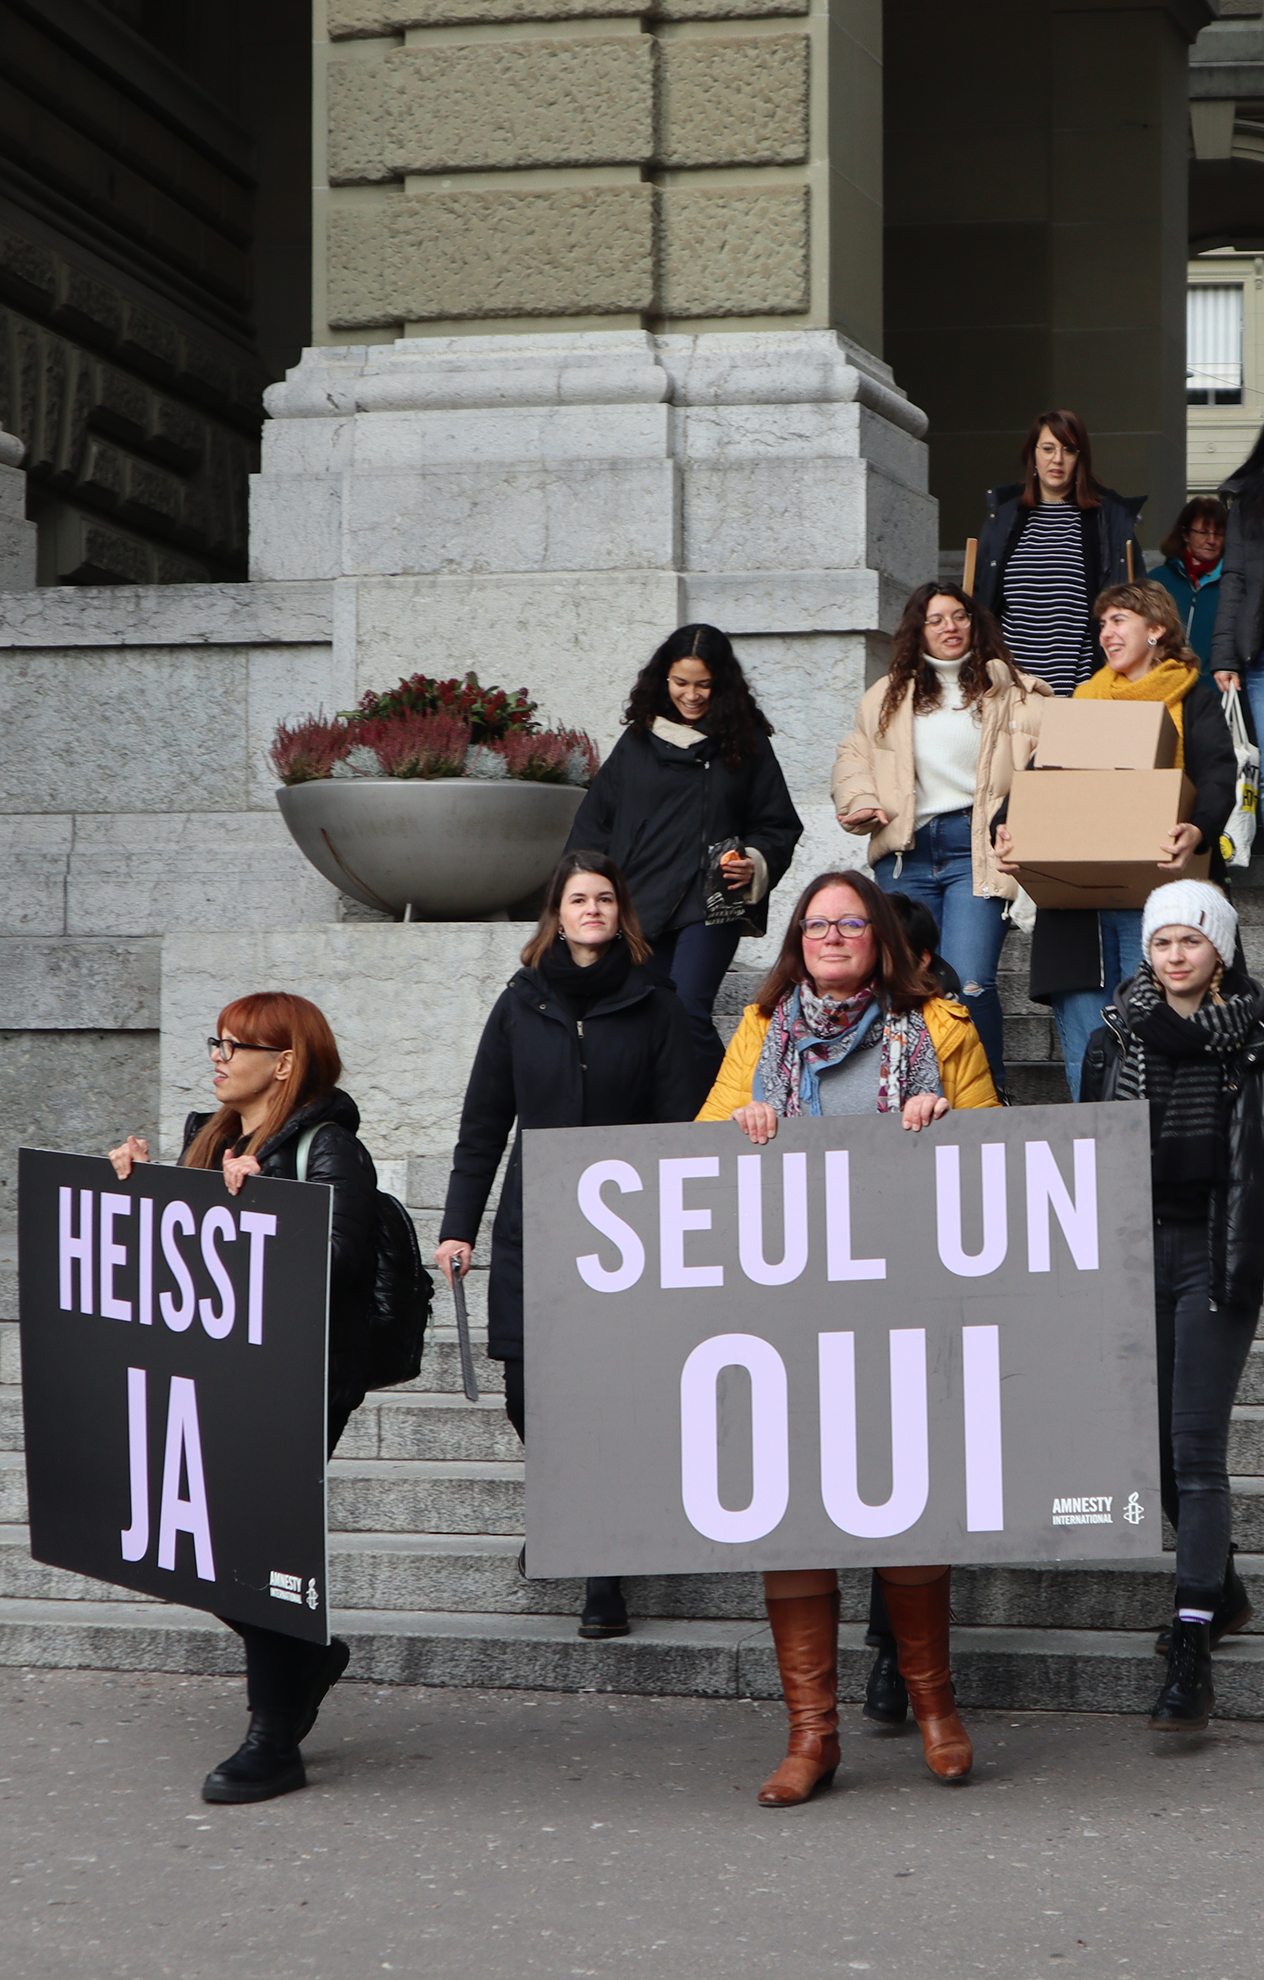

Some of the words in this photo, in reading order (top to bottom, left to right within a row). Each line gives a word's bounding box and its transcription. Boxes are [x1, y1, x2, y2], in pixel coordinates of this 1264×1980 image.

[60, 1187, 276, 1344] HEISST
[576, 1151, 886, 1292] SEUL
[936, 1139, 1099, 1277] UN
[122, 1368, 215, 1581] JA
[681, 1325, 1003, 1543] OUI
[1052, 1496, 1113, 1513] AMNESTY
[269, 1570, 302, 1593] AMNESTY
[1052, 1514, 1113, 1526] INTERNATIONAL
